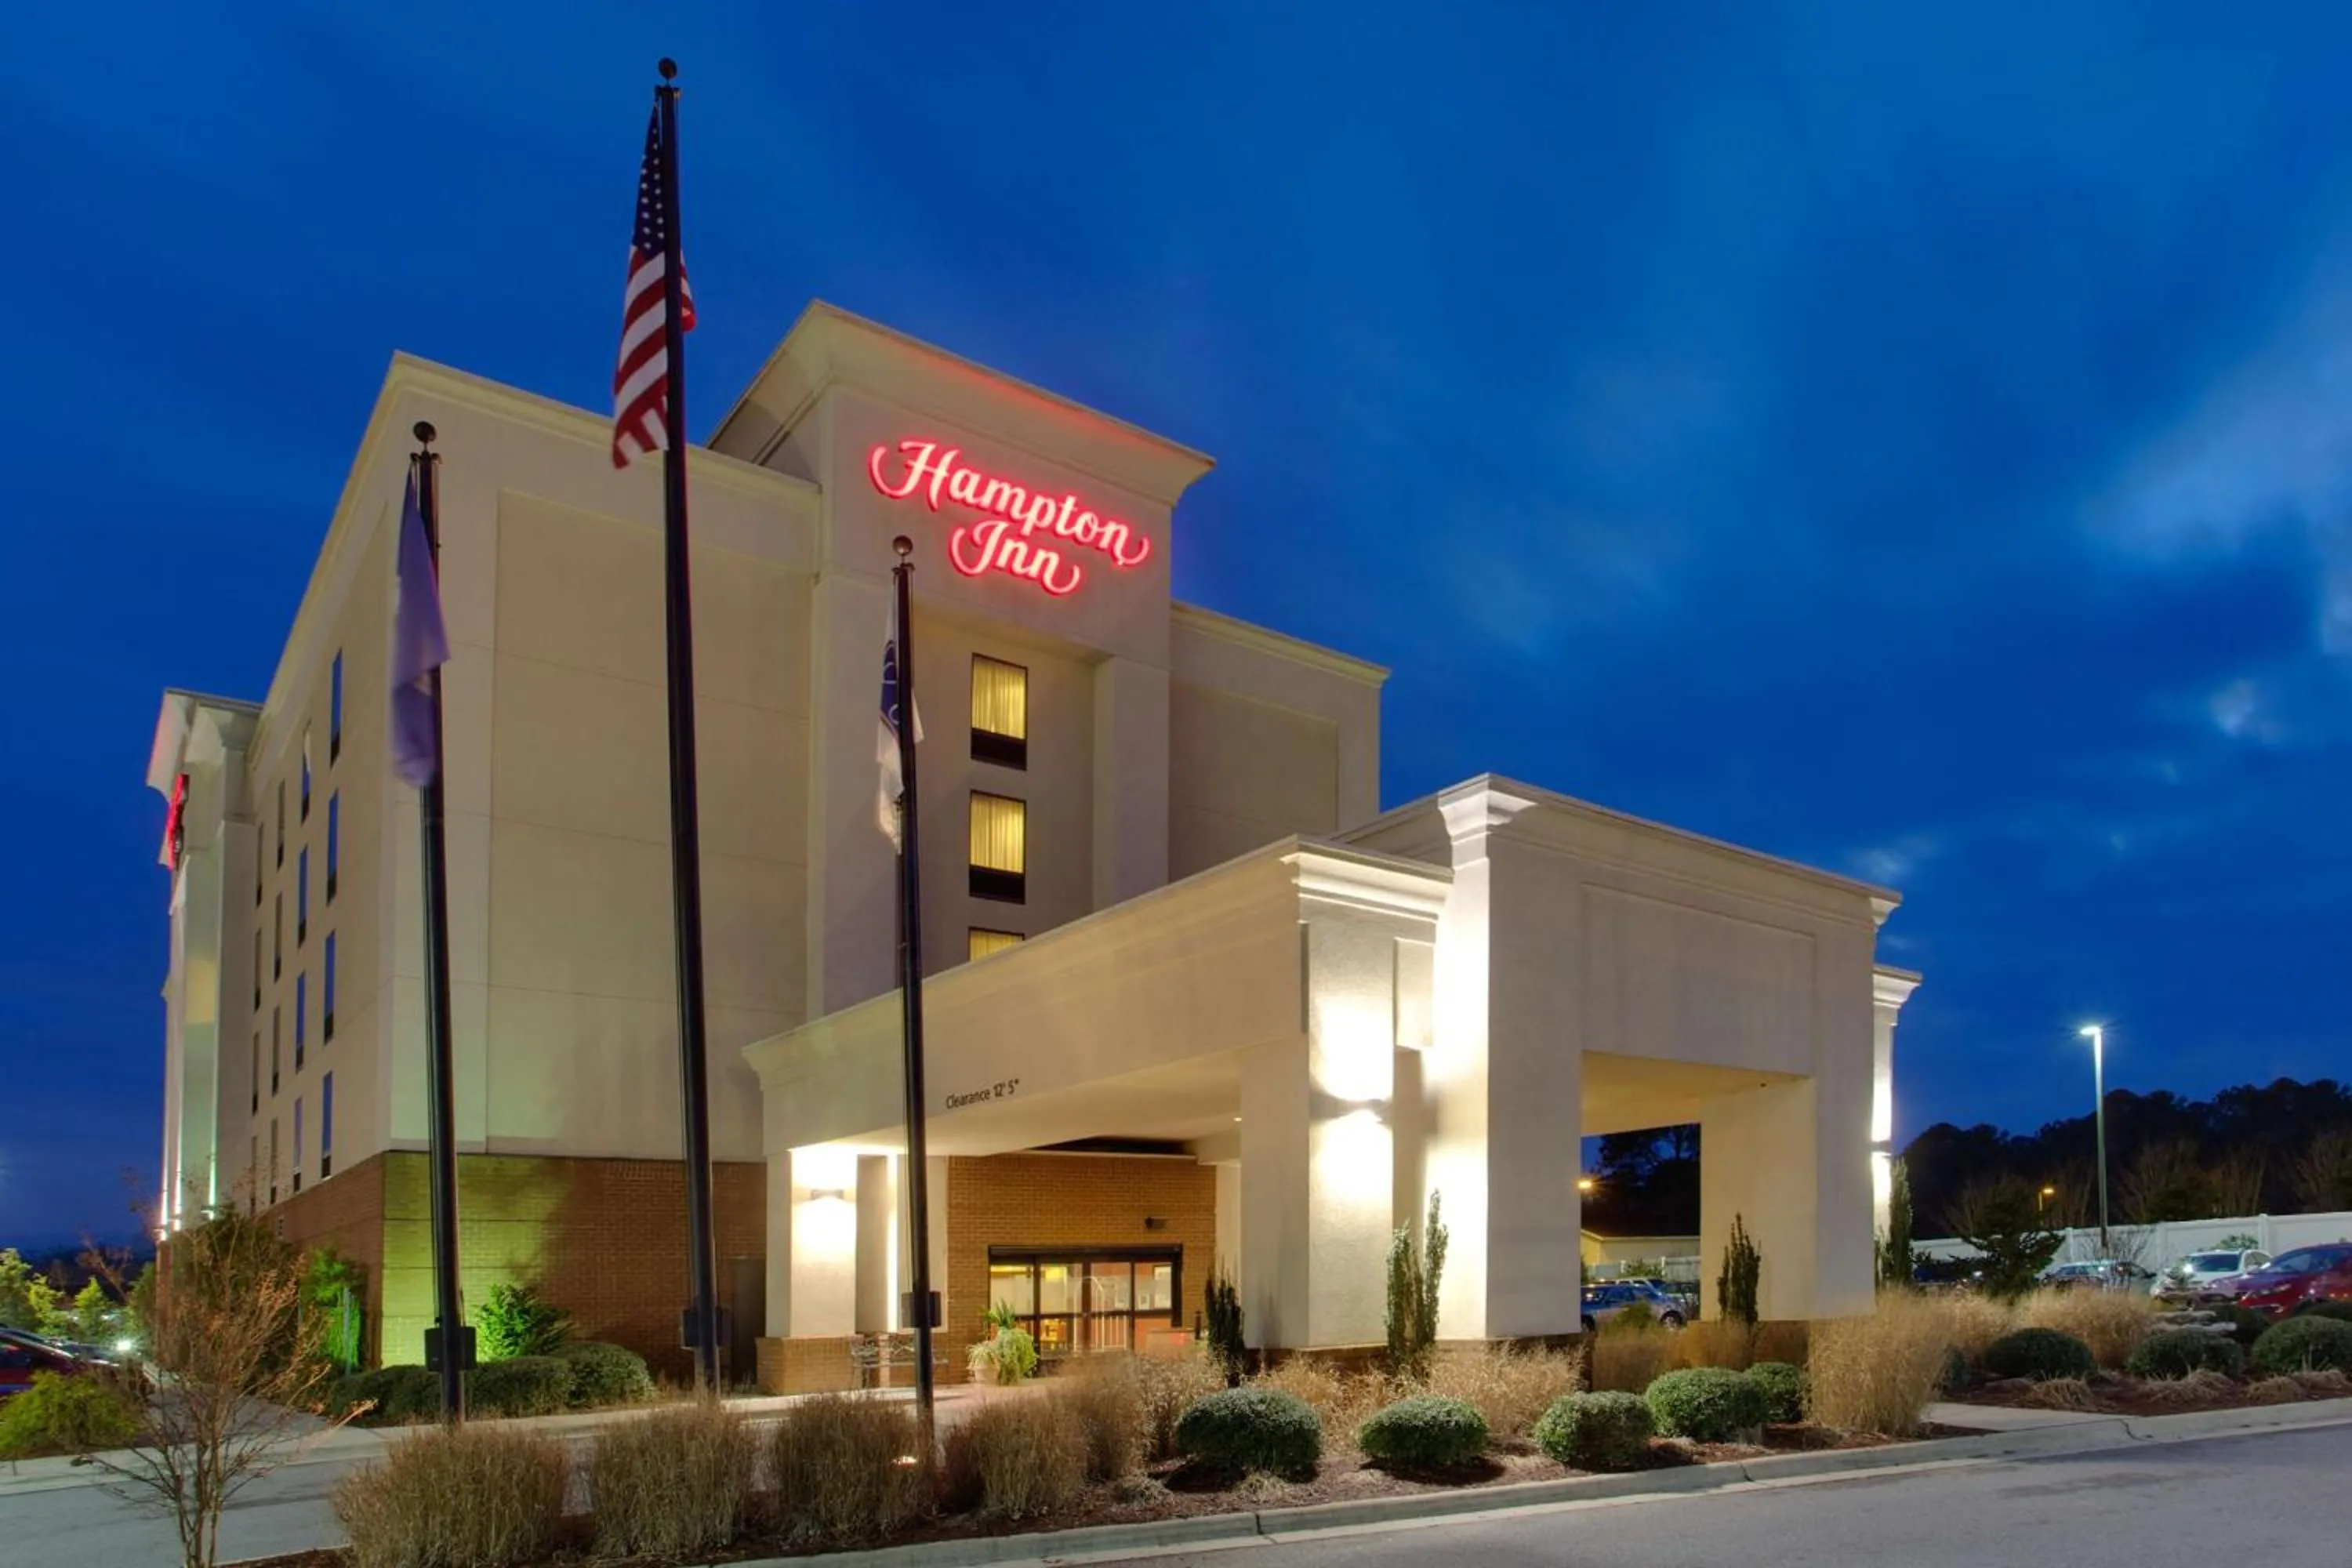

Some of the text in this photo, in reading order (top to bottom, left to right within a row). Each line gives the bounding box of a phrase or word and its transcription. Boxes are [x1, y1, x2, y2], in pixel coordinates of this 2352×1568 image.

[870, 440, 1149, 565] Hampton
[950, 519, 1081, 595] Inn
[946, 1088, 990, 1109] Clearance
